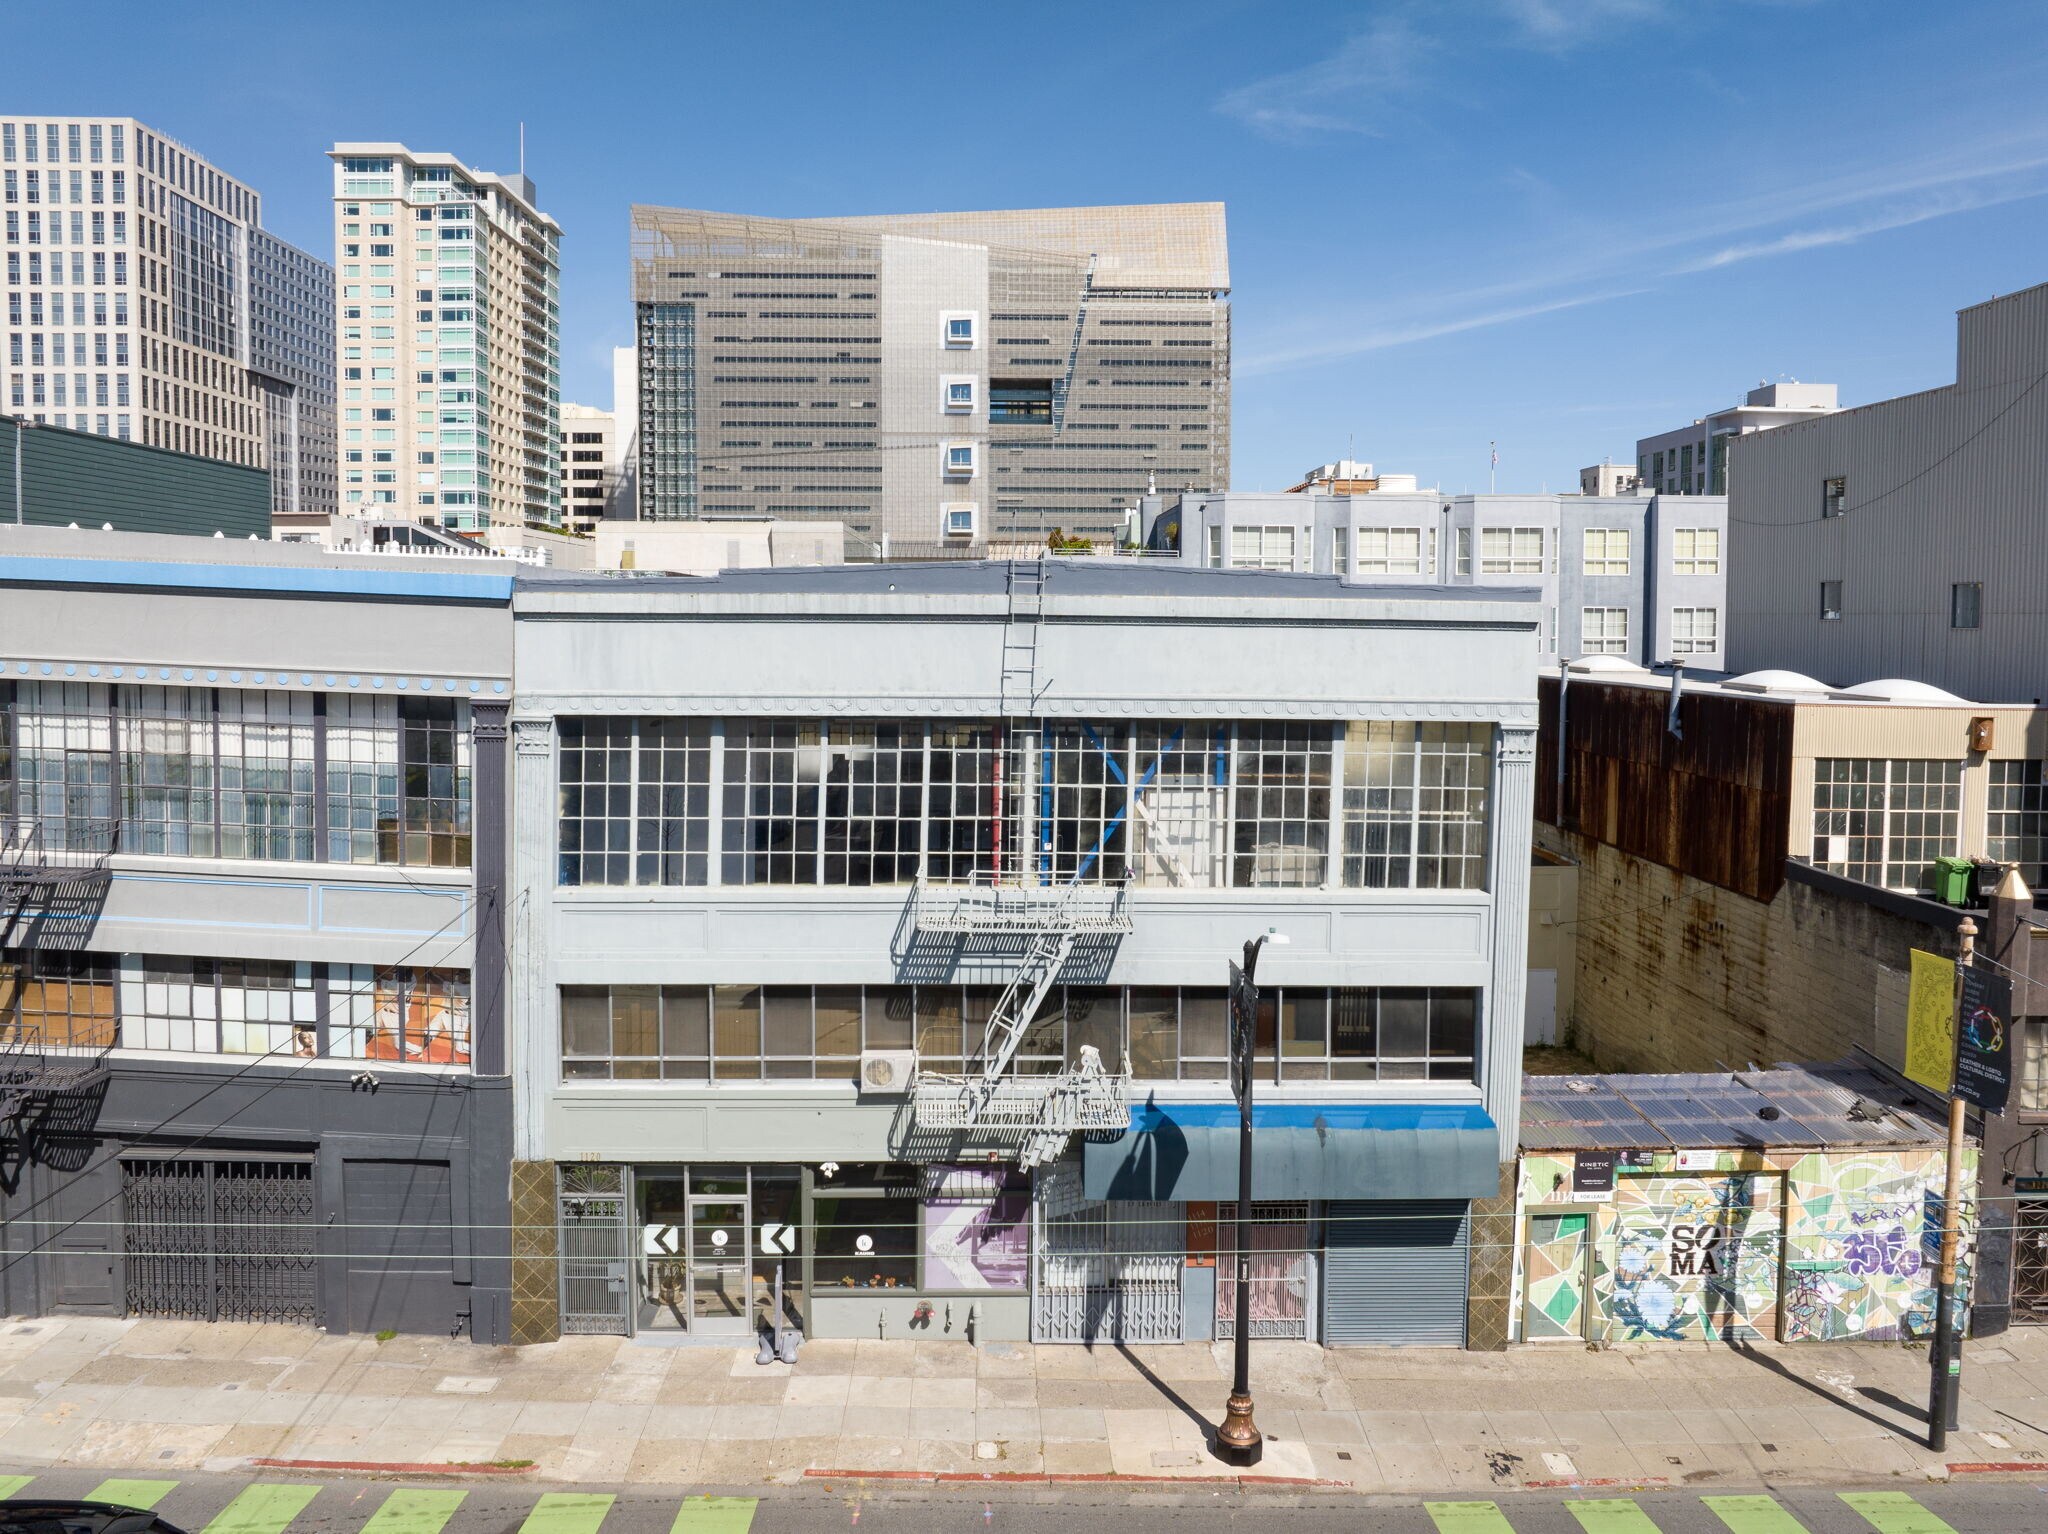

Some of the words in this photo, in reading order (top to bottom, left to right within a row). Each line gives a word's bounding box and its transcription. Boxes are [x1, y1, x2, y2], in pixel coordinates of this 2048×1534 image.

[1959, 1063, 1984, 1077] CULTURAL
[1984, 1072, 2006, 1084] DISTRICT
[1960, 1057, 1981, 1069] LEATHER
[1671, 1225, 1721, 1253] SO
[1670, 1251, 1718, 1276] MA
